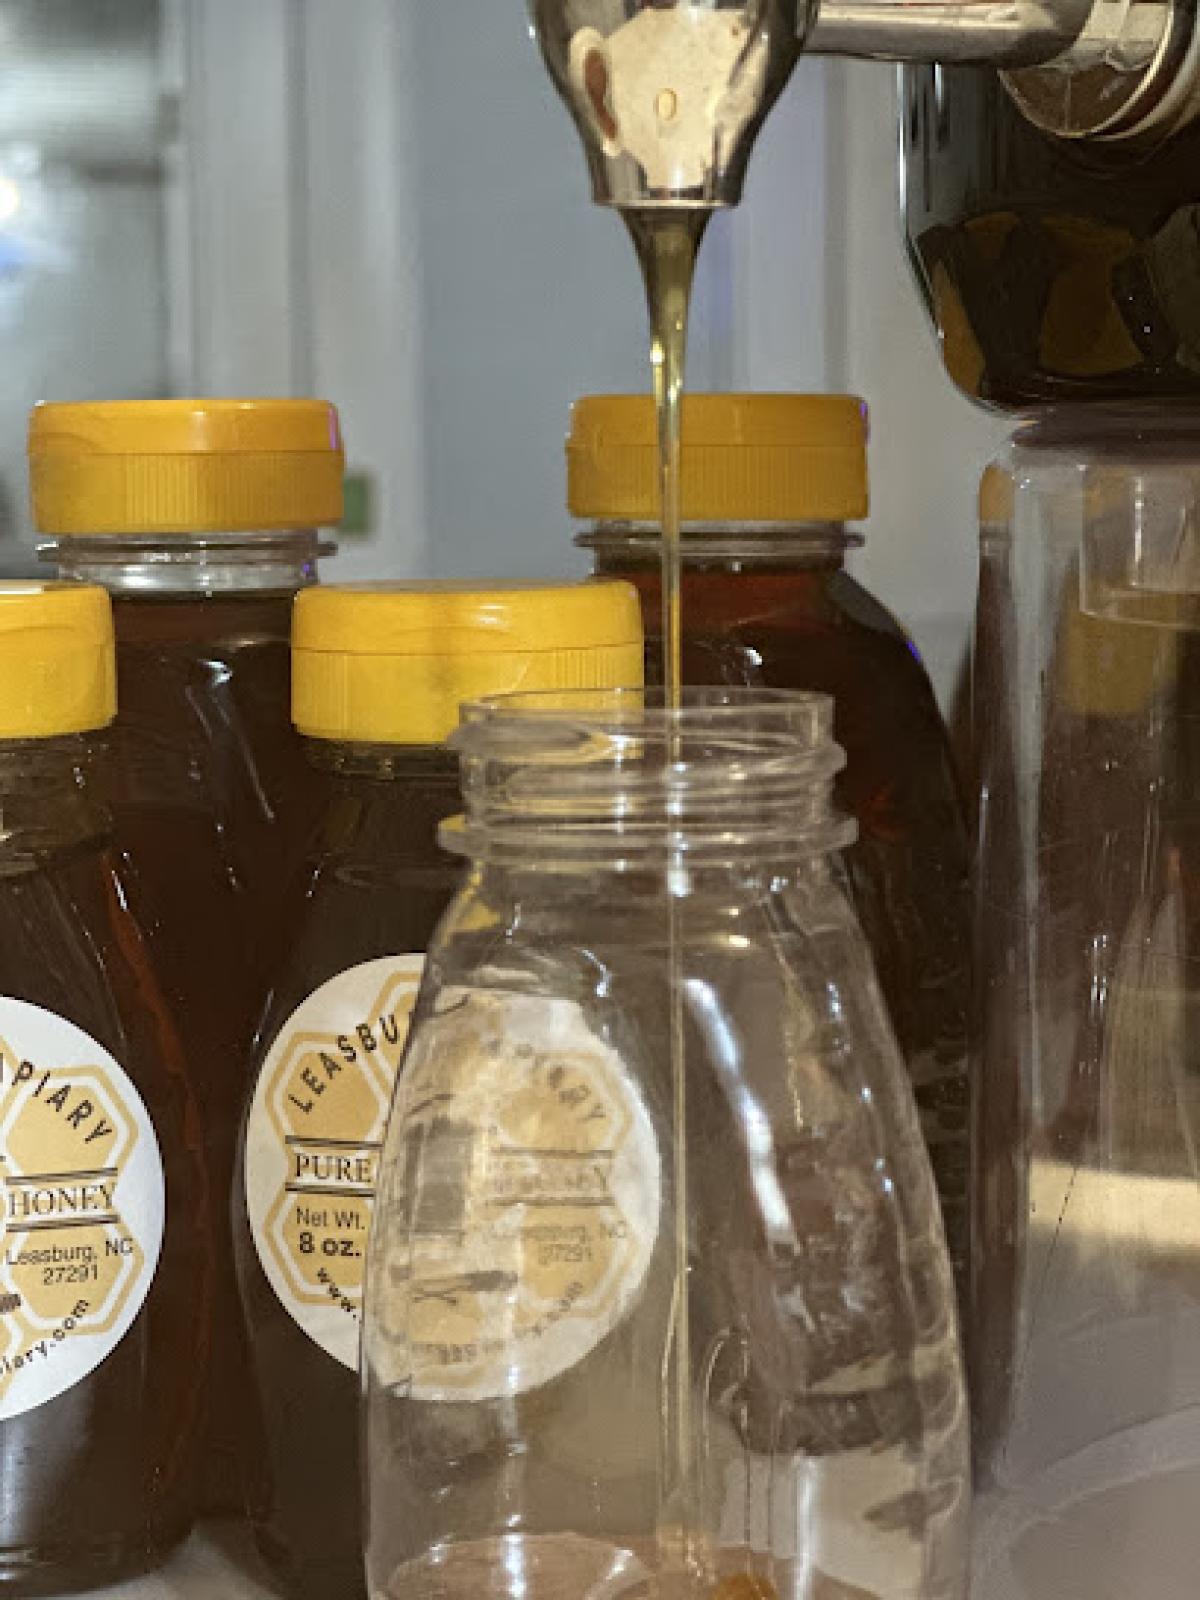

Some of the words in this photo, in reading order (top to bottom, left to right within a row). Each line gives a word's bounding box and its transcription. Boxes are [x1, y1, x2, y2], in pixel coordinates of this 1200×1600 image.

[288, 1014, 400, 1114] LEASBU
[0, 1053, 113, 1143] PIARY
[295, 1153, 372, 1183] PURE
[8, 1182, 118, 1217] HONEY
[296, 1206, 328, 1227] Net
[333, 1210, 366, 1230] Wt.
[5, 1244, 98, 1266] Leasburg,
[105, 1238, 134, 1257] NC
[299, 1231, 315, 1254] 8
[321, 1238, 362, 1257] oz.
[43, 1264, 99, 1286] 27291
[317, 1267, 357, 1319] www.
